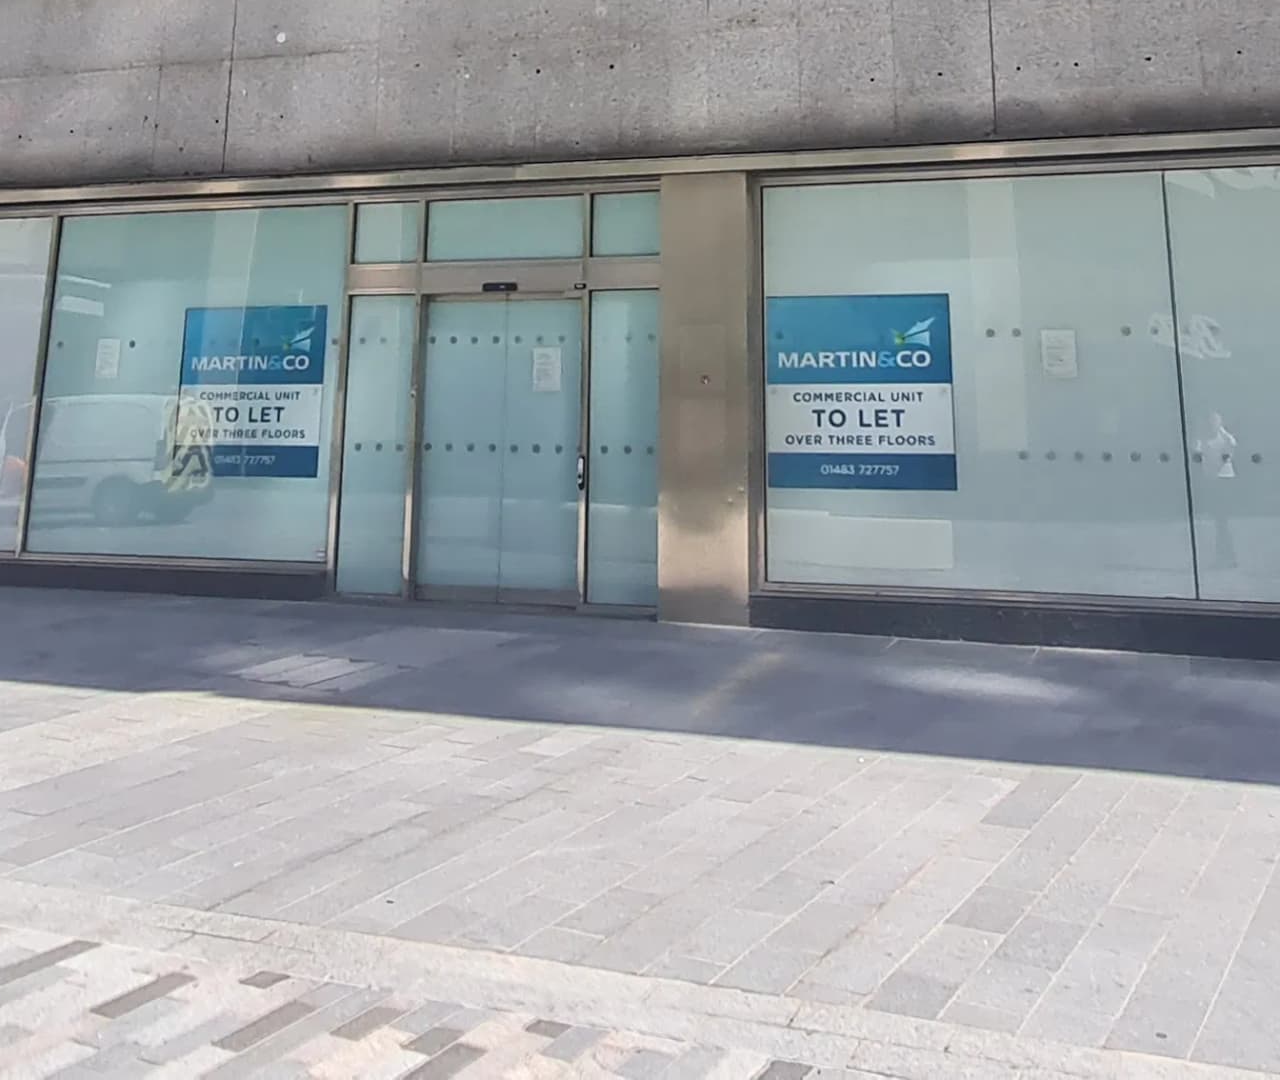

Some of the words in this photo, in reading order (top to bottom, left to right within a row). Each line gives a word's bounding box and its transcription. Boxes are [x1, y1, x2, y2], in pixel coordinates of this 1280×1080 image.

[191, 354, 310, 371] MARTIN&CO
[777, 350, 932, 369] MARTIN&CO
[200, 391, 271, 401] COMMERCIAL
[275, 391, 302, 400] UNIT
[793, 392, 886, 403] COMMERCIAL
[890, 391, 924, 402] UNIT
[213, 406, 240, 423] TO
[248, 406, 286, 423] LET
[812, 409, 847, 428] TO
[859, 409, 906, 428] LET
[190, 429, 219, 439] OVER
[223, 429, 257, 439] THREE
[261, 429, 306, 439] FLOORS
[785, 434, 822, 446] OVER
[828, 435, 873, 446] THREE
[878, 435, 936, 446] FLOORS
[820, 464, 855, 476] 01483
[858, 464, 900, 477] 727757
